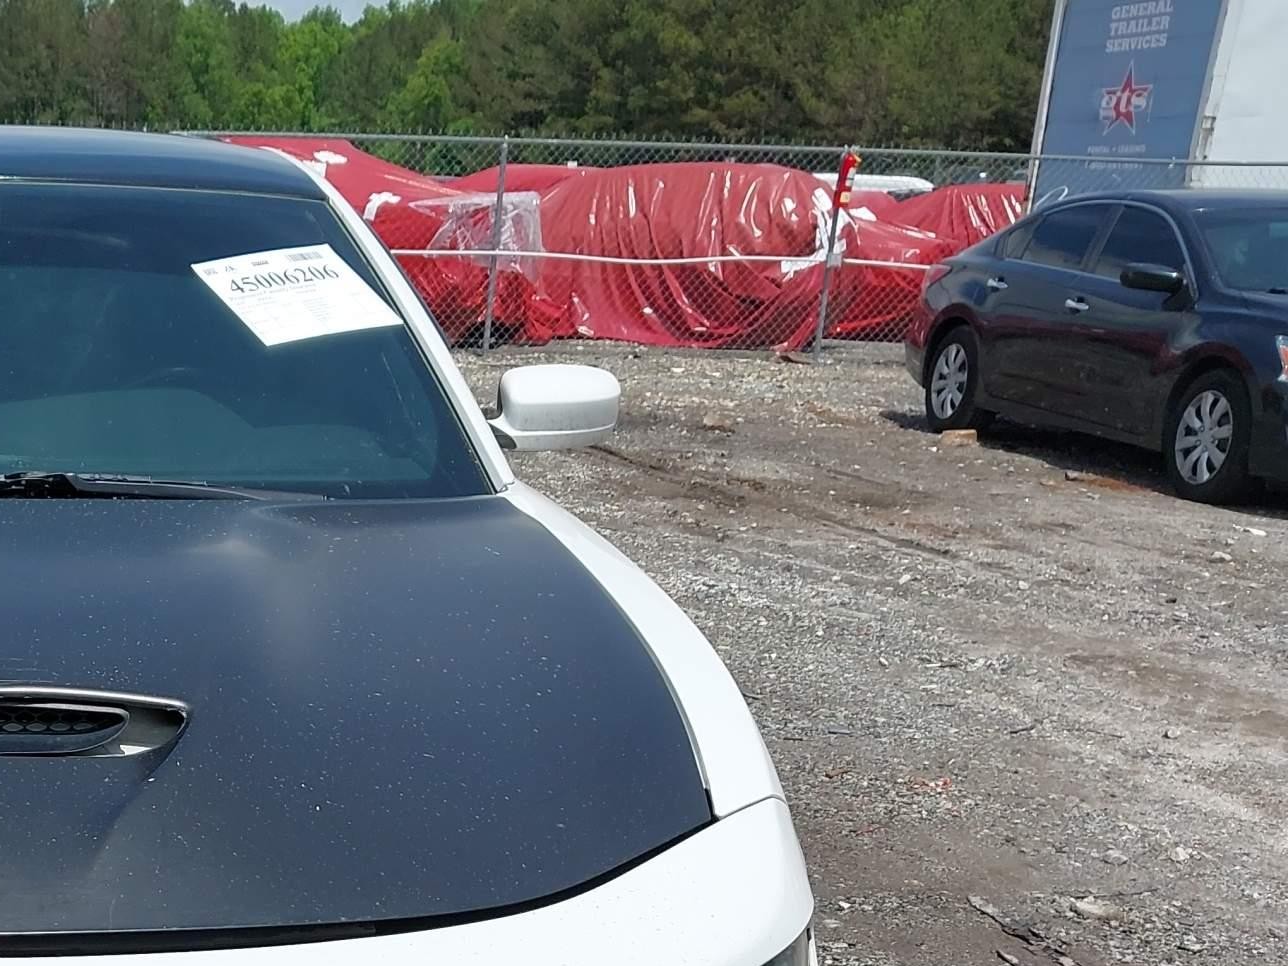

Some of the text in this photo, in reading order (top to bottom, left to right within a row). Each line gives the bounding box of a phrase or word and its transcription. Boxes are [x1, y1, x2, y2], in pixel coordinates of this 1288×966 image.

[1111, 0, 1173, 19] GENERAL
[1109, 15, 1170, 36] TRAILER
[1105, 33, 1168, 53] SERVICES
[229, 264, 340, 294] 45006206
